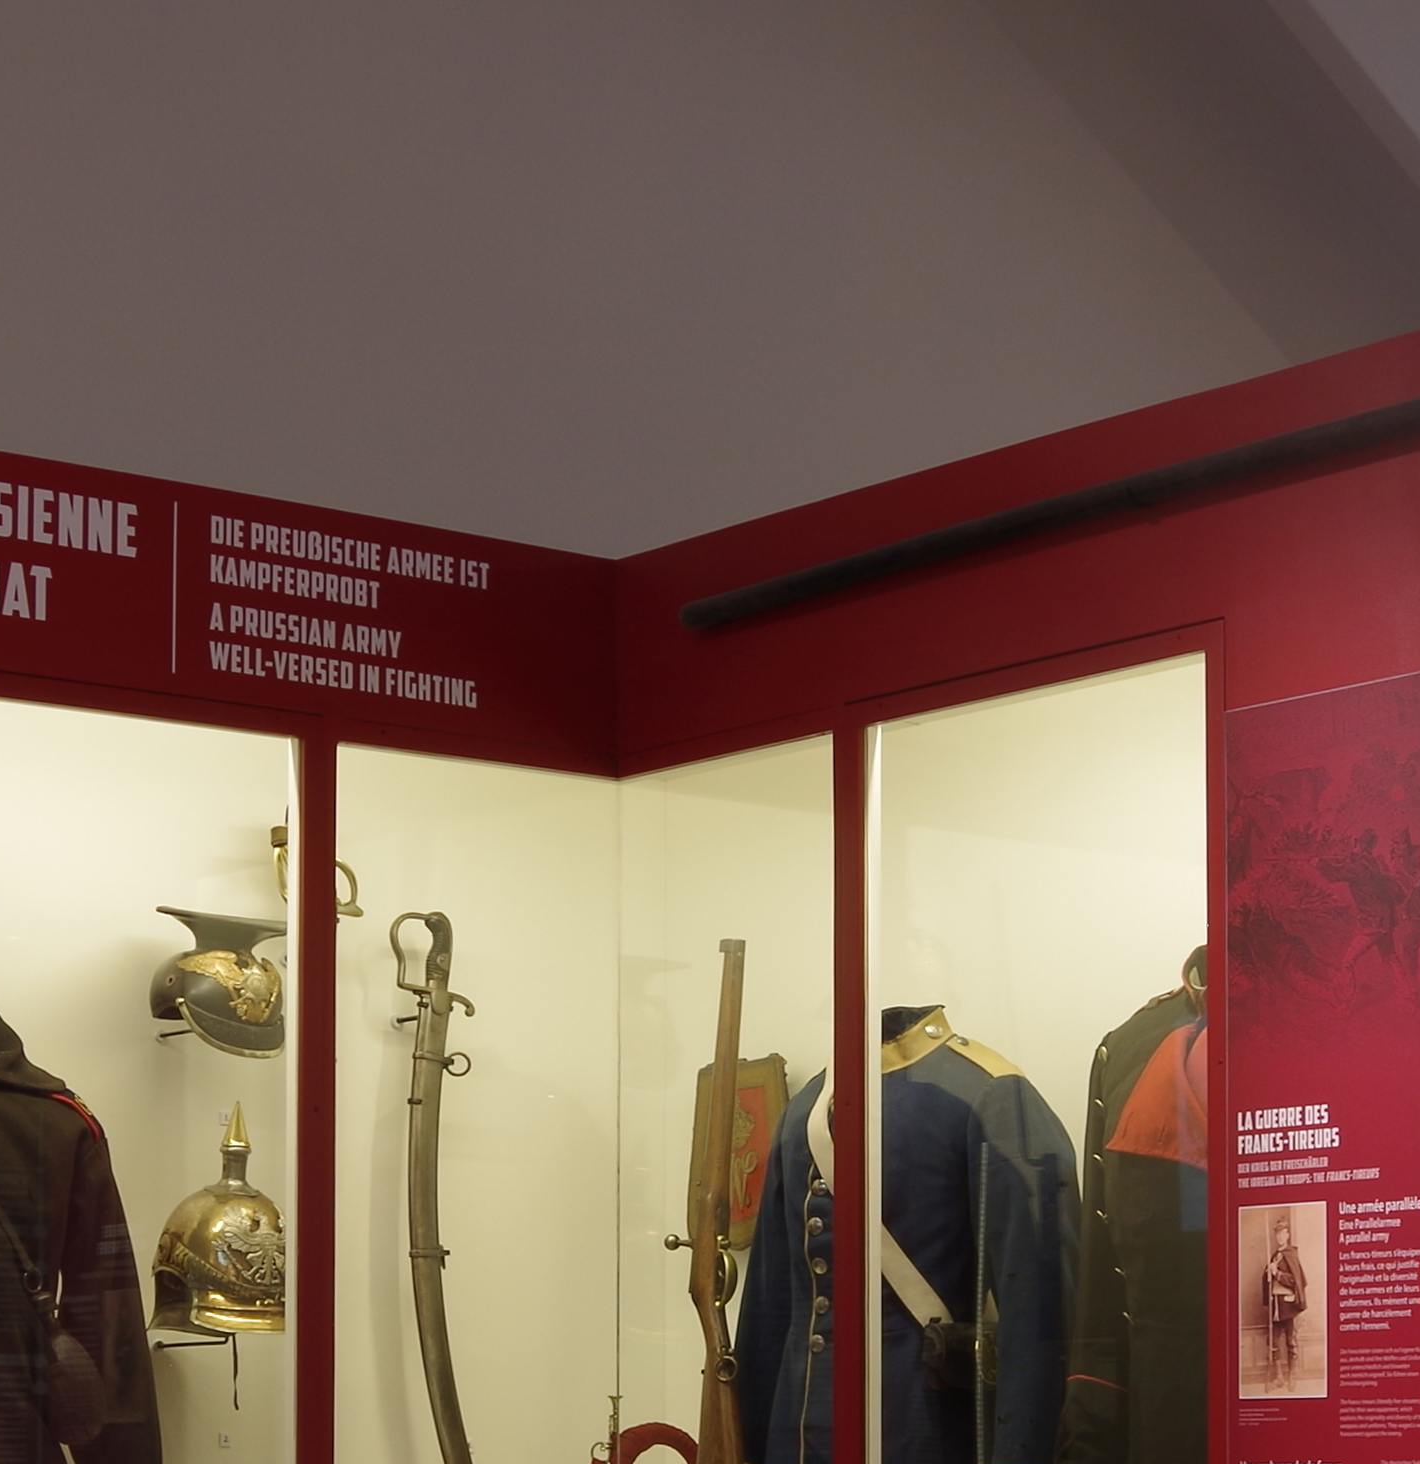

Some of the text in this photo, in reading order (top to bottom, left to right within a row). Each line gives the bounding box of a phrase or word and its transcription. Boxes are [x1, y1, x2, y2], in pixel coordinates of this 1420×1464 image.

[210, 514, 244, 562] DIE
[386, 546, 454, 584] ARMEE
[459, 558, 488, 589] IST
[209, 553, 379, 609] KAMPFERPROBT
[209, 602, 401, 658] A PRUSSIAN ARMY
[208, 640, 477, 708] WELL-VERSED IN FIGHTING
[1237, 1103, 1328, 1131] LA GUERRE DES
[1237, 1127, 1339, 1155] FRANCS-TIREURS
[1338, 1201, 1356, 1214] Une
[1356, 1199, 1384, 1213] armée
[1338, 1231, 1389, 1245] A parallel army
